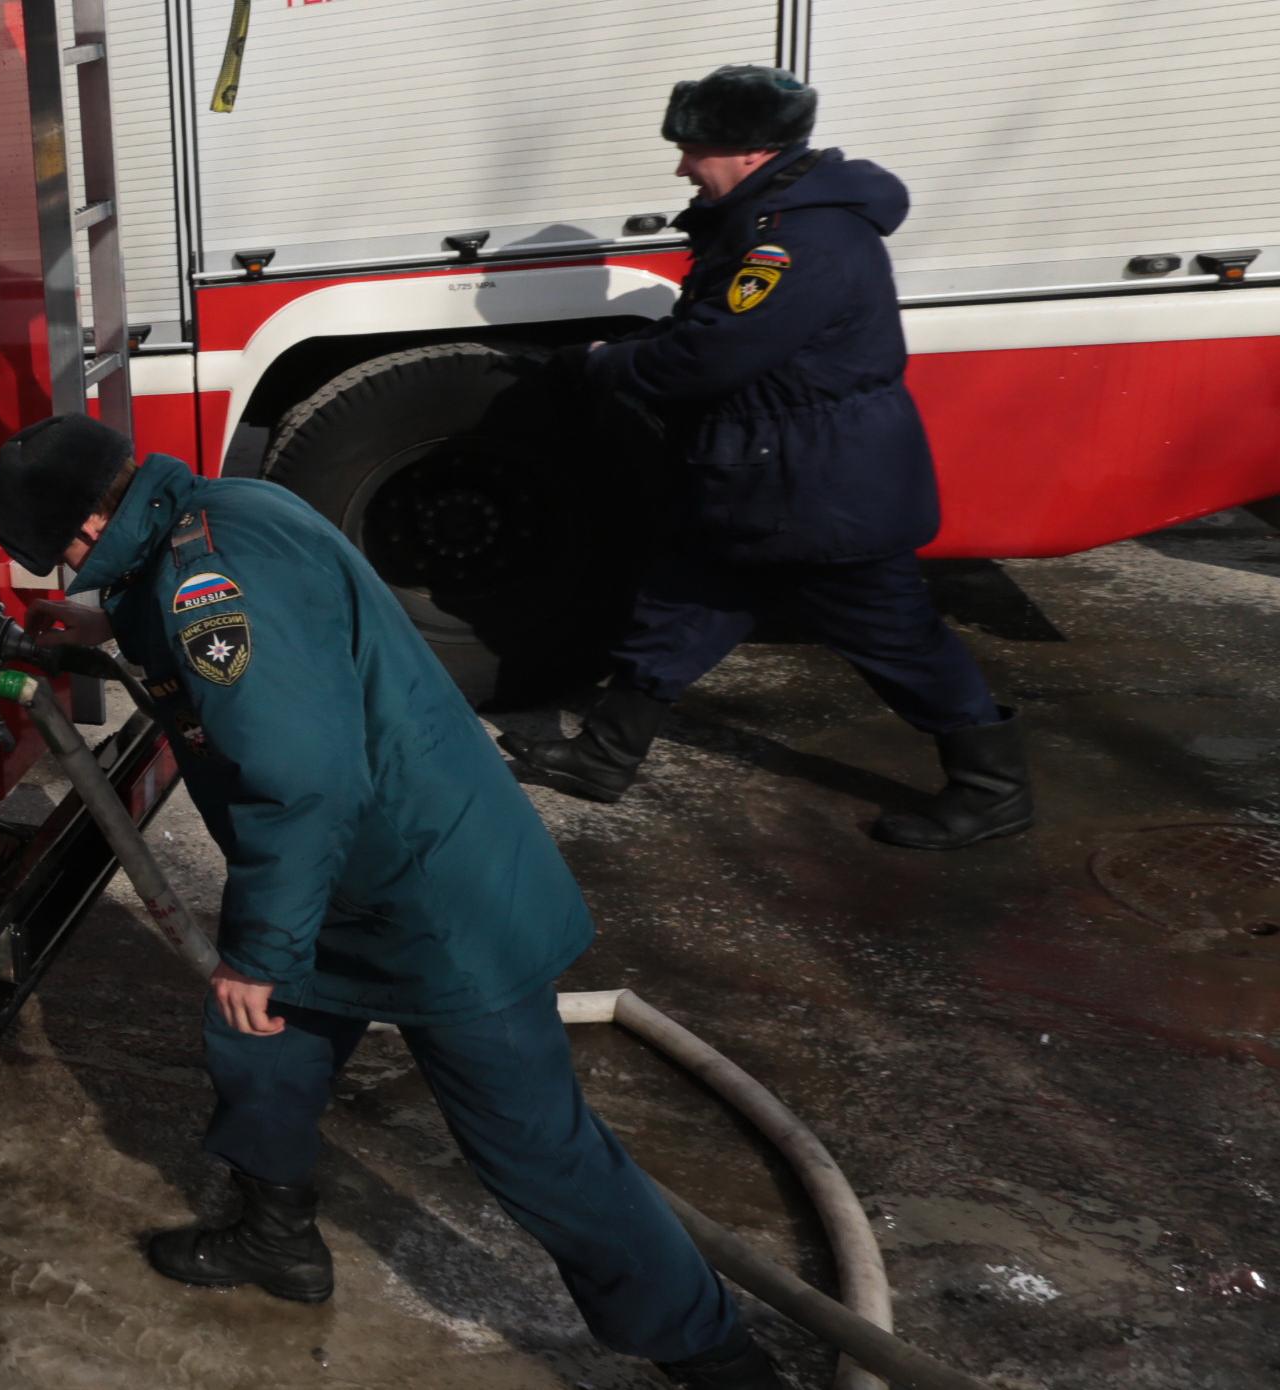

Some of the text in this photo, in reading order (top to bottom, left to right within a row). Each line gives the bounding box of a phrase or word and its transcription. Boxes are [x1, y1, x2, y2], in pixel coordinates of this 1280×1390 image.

[184, 590, 227, 608] RUSSIA
[183, 614, 244, 639] МЧС РОССИИ
